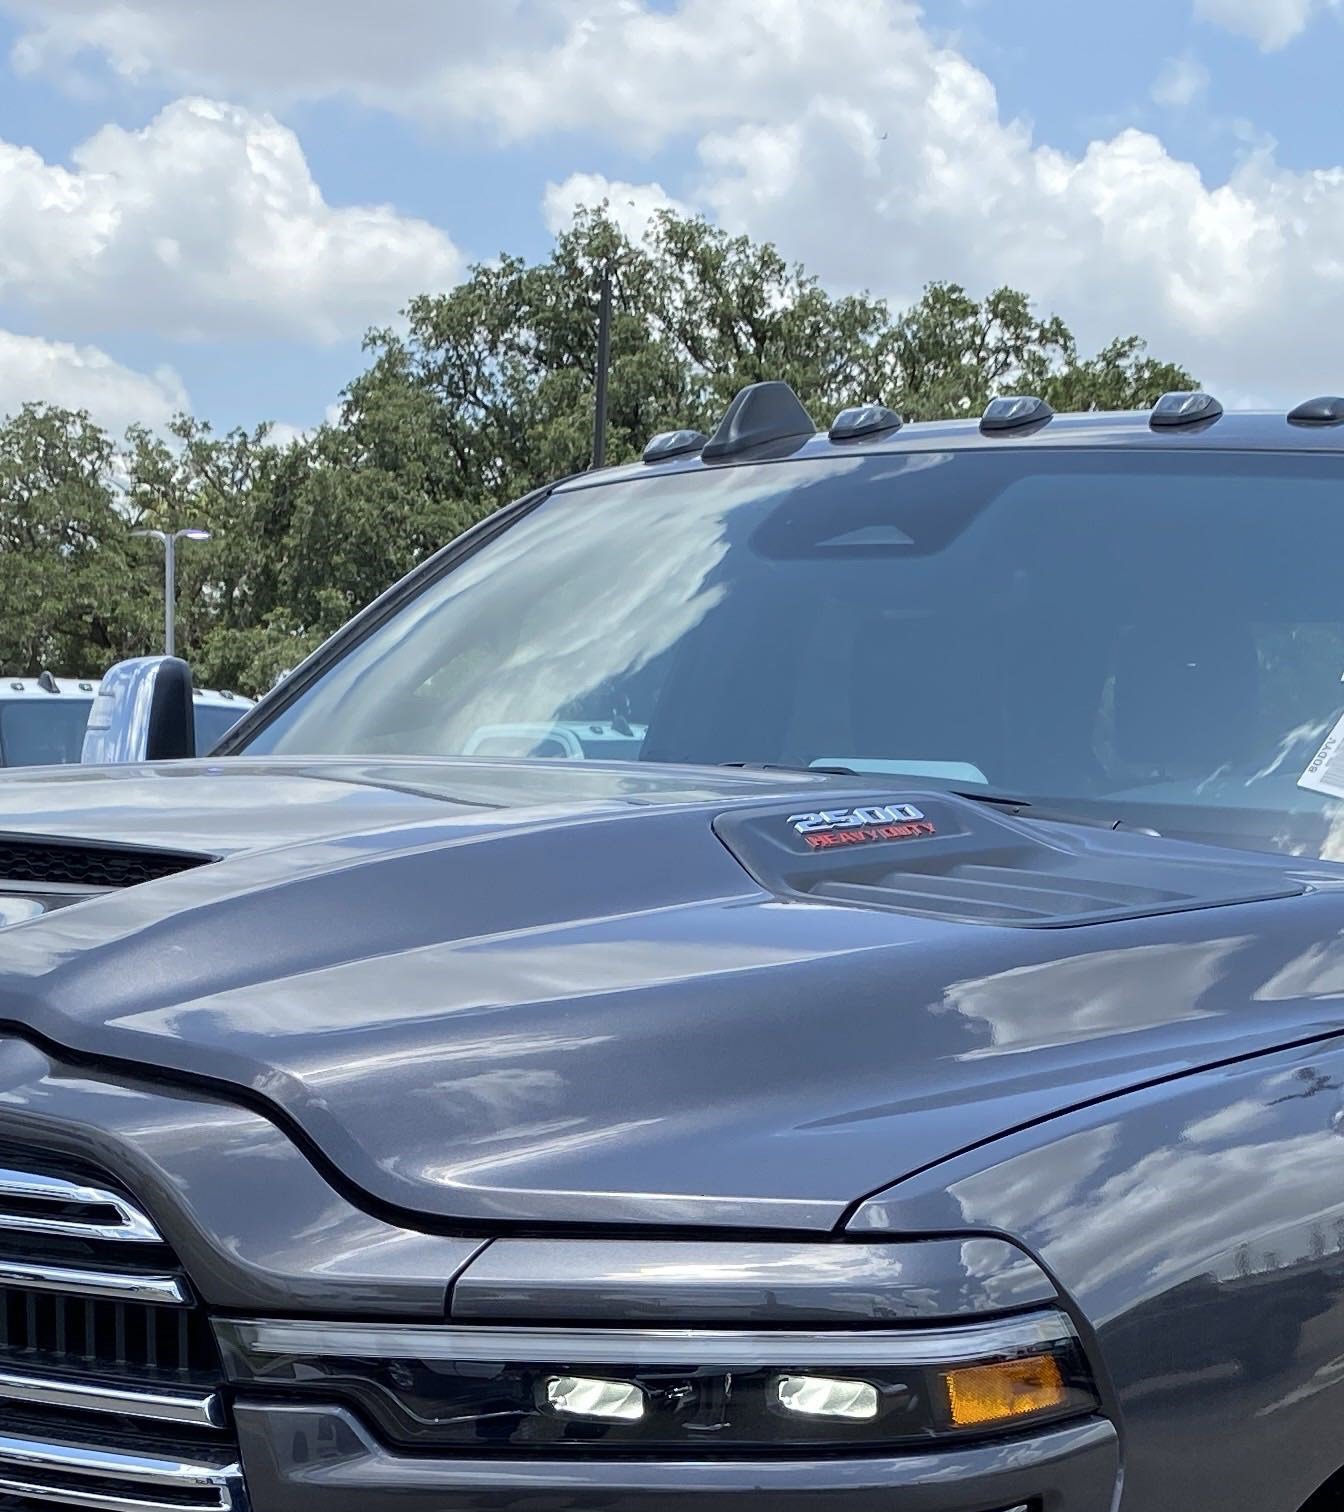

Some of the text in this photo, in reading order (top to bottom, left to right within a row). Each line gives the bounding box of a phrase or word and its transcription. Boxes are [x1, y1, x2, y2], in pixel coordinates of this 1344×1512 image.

[786, 803, 925, 834] 2500
[805, 822, 936, 848] HEAVY DUTY
